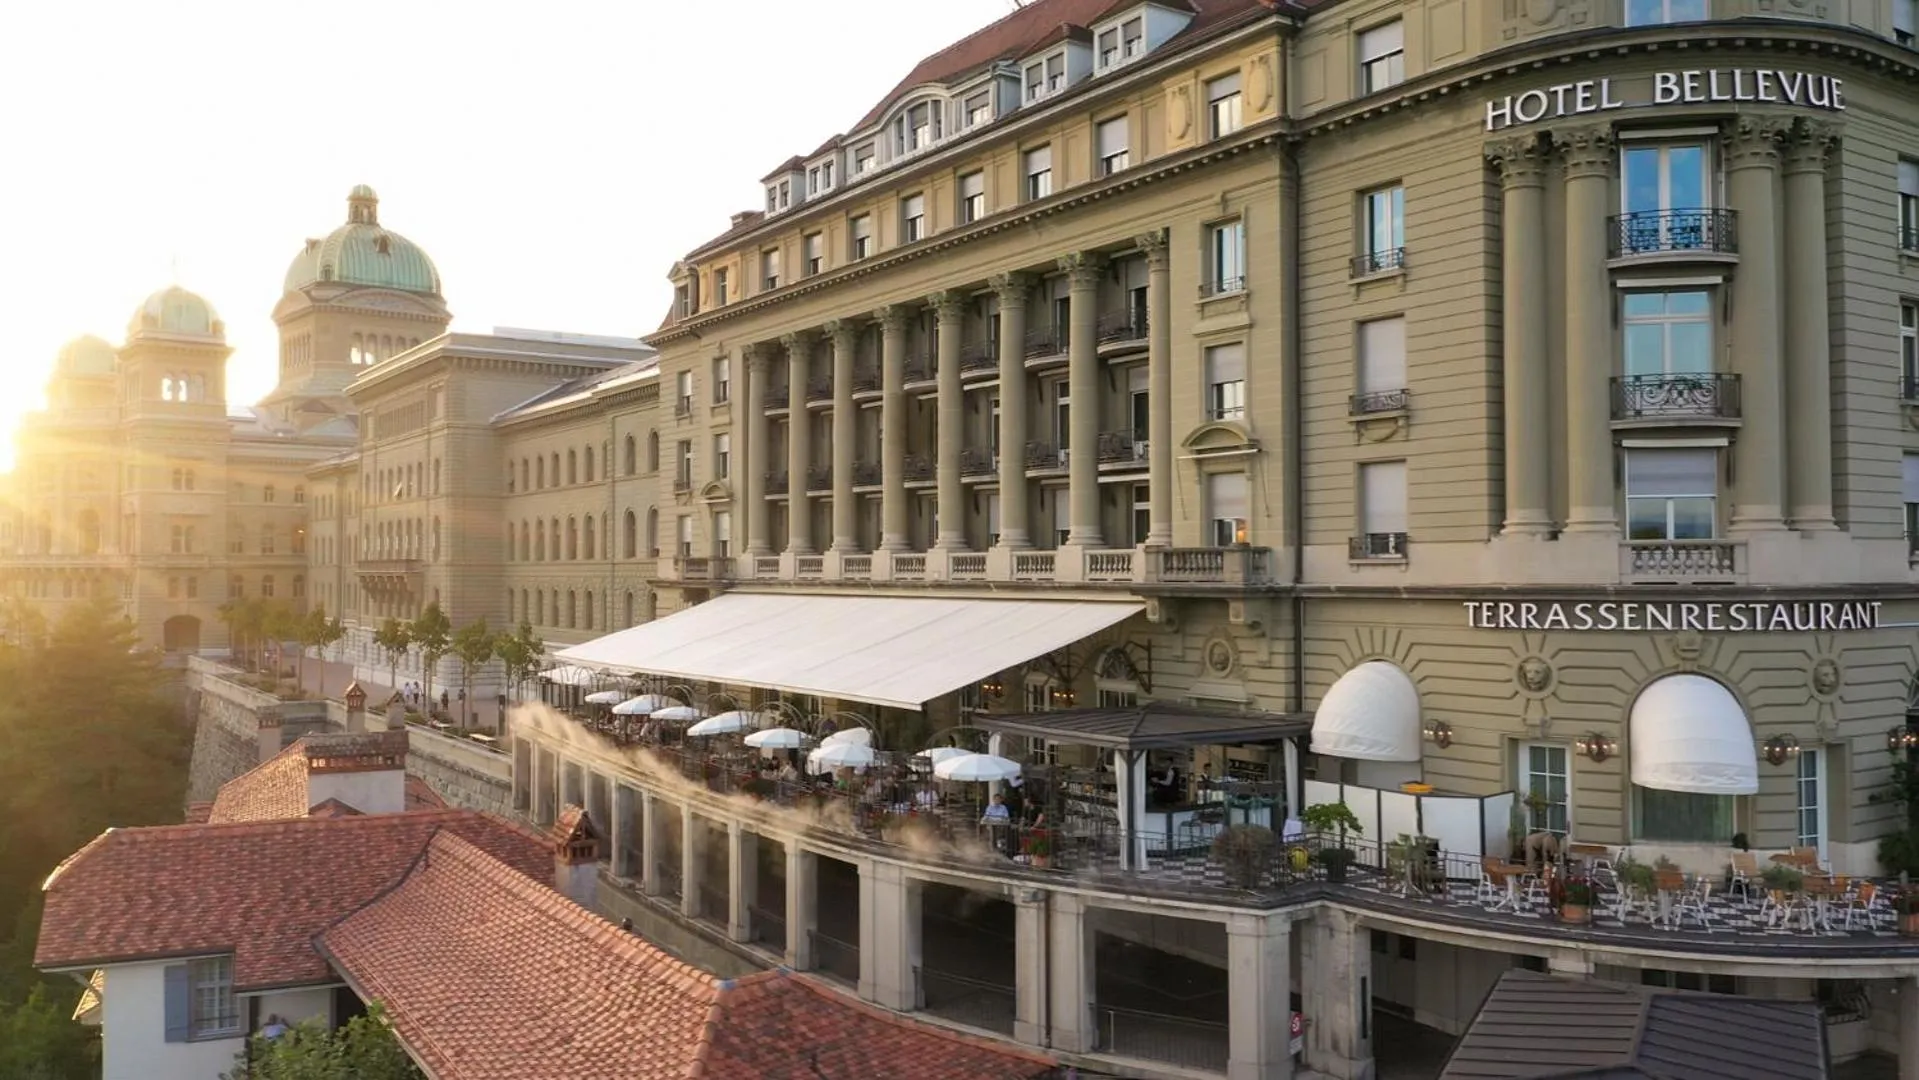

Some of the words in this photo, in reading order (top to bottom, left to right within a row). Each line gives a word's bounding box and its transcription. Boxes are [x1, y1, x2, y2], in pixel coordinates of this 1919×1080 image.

[1485, 78, 1623, 131] HOTEL
[1653, 69, 1847, 111] BELLEVUE
[1463, 602, 1882, 631] TERRASSENRESTAURANT
